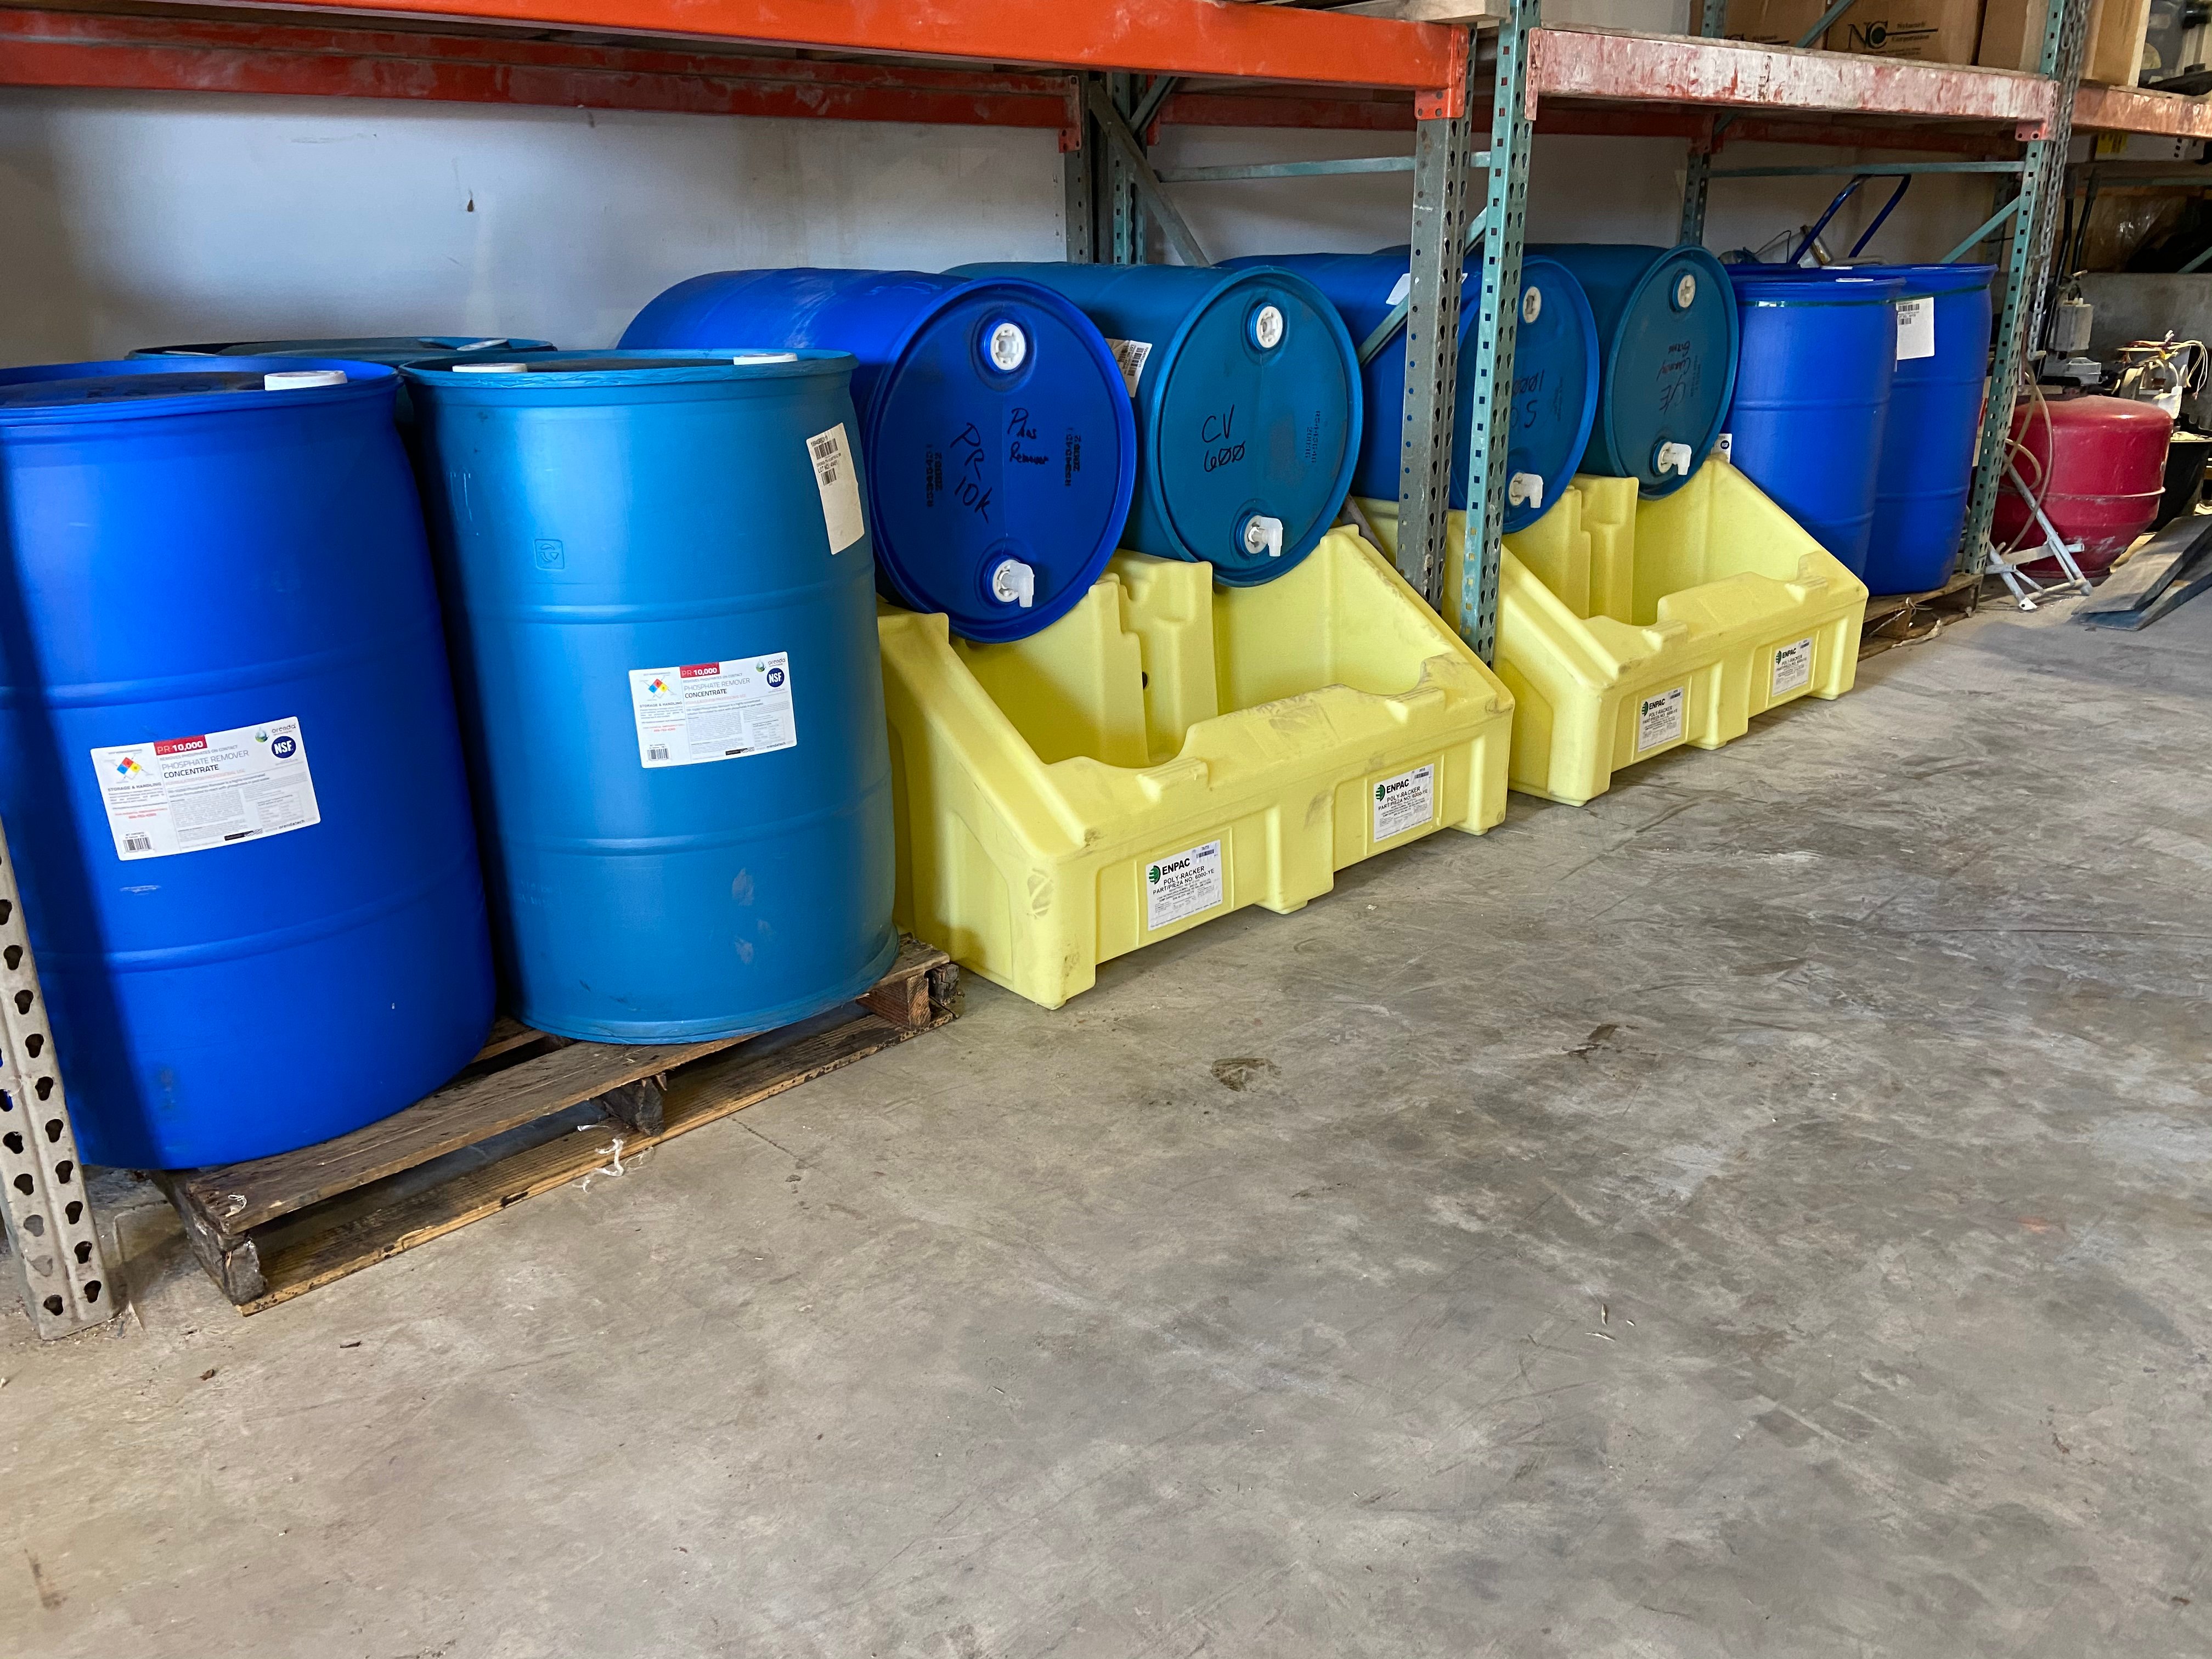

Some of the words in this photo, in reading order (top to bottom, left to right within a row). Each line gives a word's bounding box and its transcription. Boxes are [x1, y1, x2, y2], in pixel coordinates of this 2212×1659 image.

[1201, 403, 1235, 443] CV
[1782, 647, 1796, 658] ENPAC
[684, 682, 721, 691] PHOSPHATE
[721, 678, 751, 687] REMOVER
[769, 672, 782, 684] NSF
[685, 689, 727, 698] CONCENTRATE
[1649, 698, 1666, 710] ENPAC
[272, 724, 296, 733] orenda
[274, 740, 292, 754] NSF
[162, 757, 210, 771] PHOSPHATE
[211, 750, 250, 763] REMOVER
[164, 764, 219, 778] CONCENTRATE
[1386, 778, 1409, 794] ENPAC
[1387, 786, 1420, 803] POLY-RACKER
[1378, 798, 1403, 811] PART/PIEZA
[1162, 857, 1190, 876] ENPAC
[1153, 880, 1183, 895] PART/PIEZA
[1195, 868, 1215, 879] 6000-YE
[1164, 866, 1205, 885] POLY-RACKER
